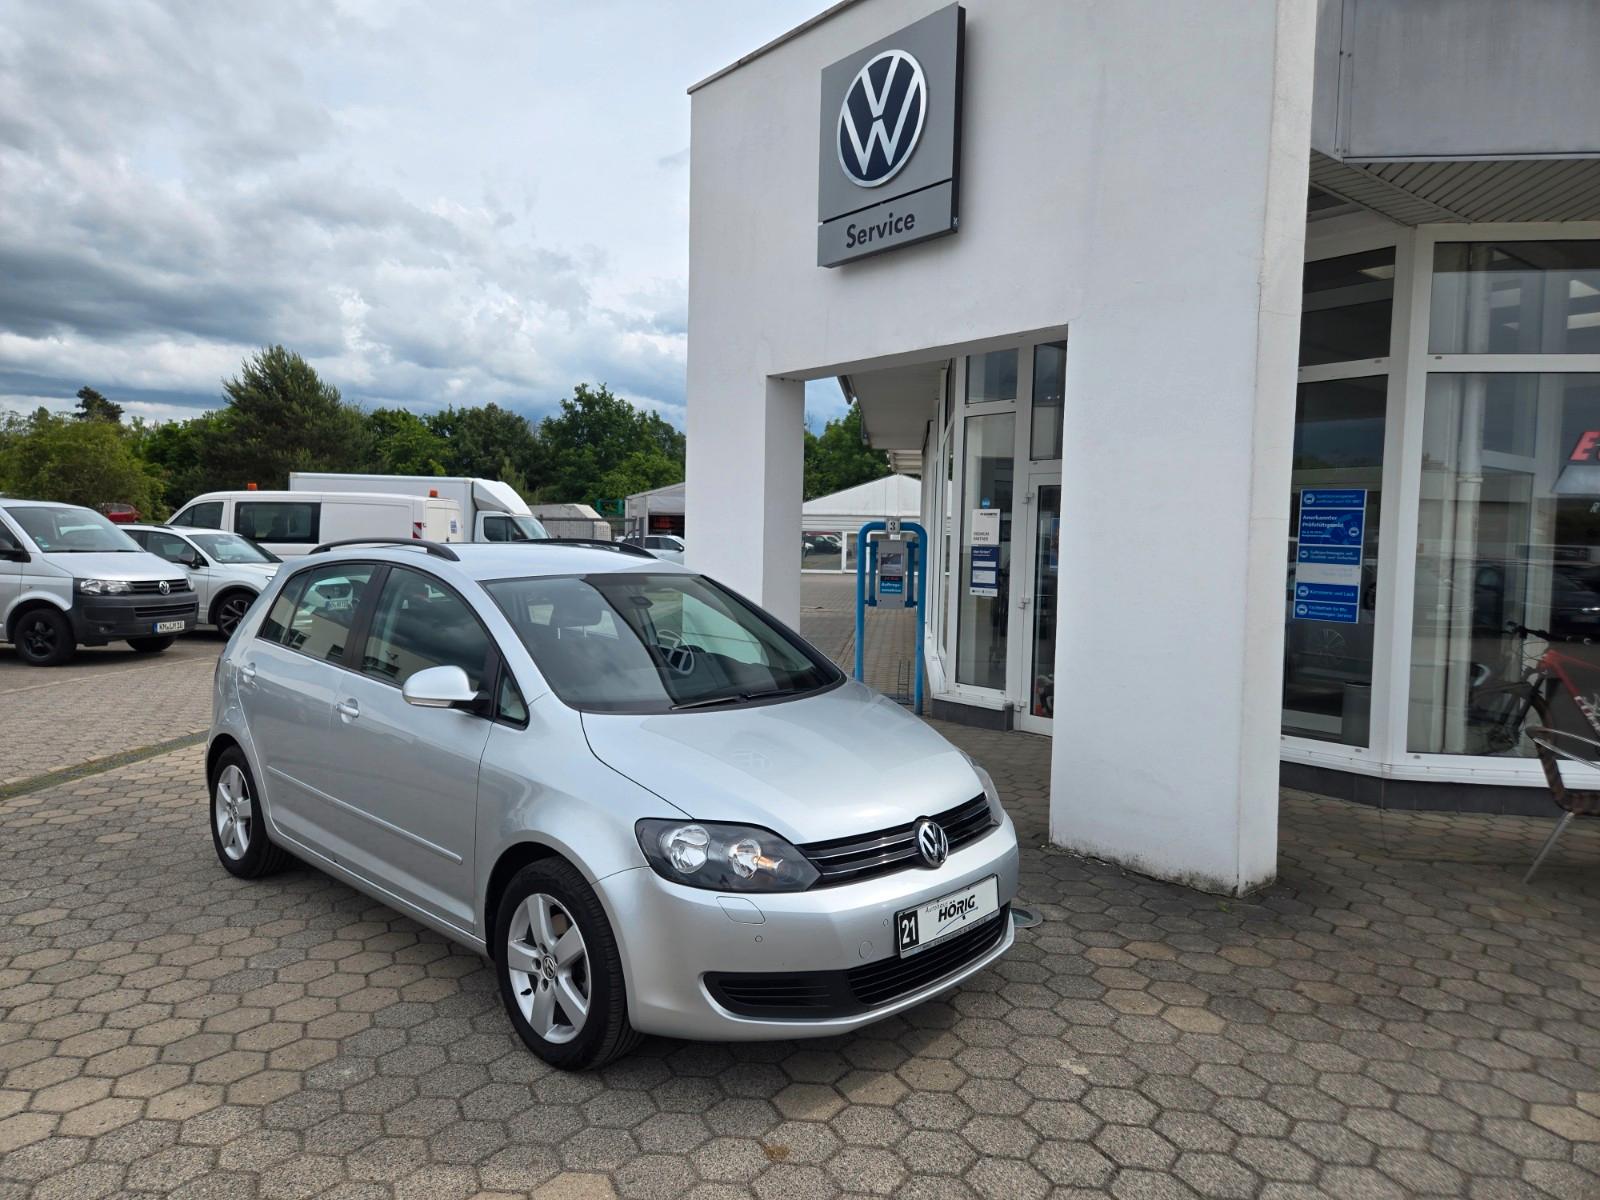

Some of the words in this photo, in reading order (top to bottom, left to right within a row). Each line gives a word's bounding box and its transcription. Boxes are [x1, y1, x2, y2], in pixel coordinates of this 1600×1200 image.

[846, 211, 916, 249] Service
[889, 520, 896, 531] 3
[938, 894, 976, 922] HÖRIG
[902, 917, 916, 944] 21
